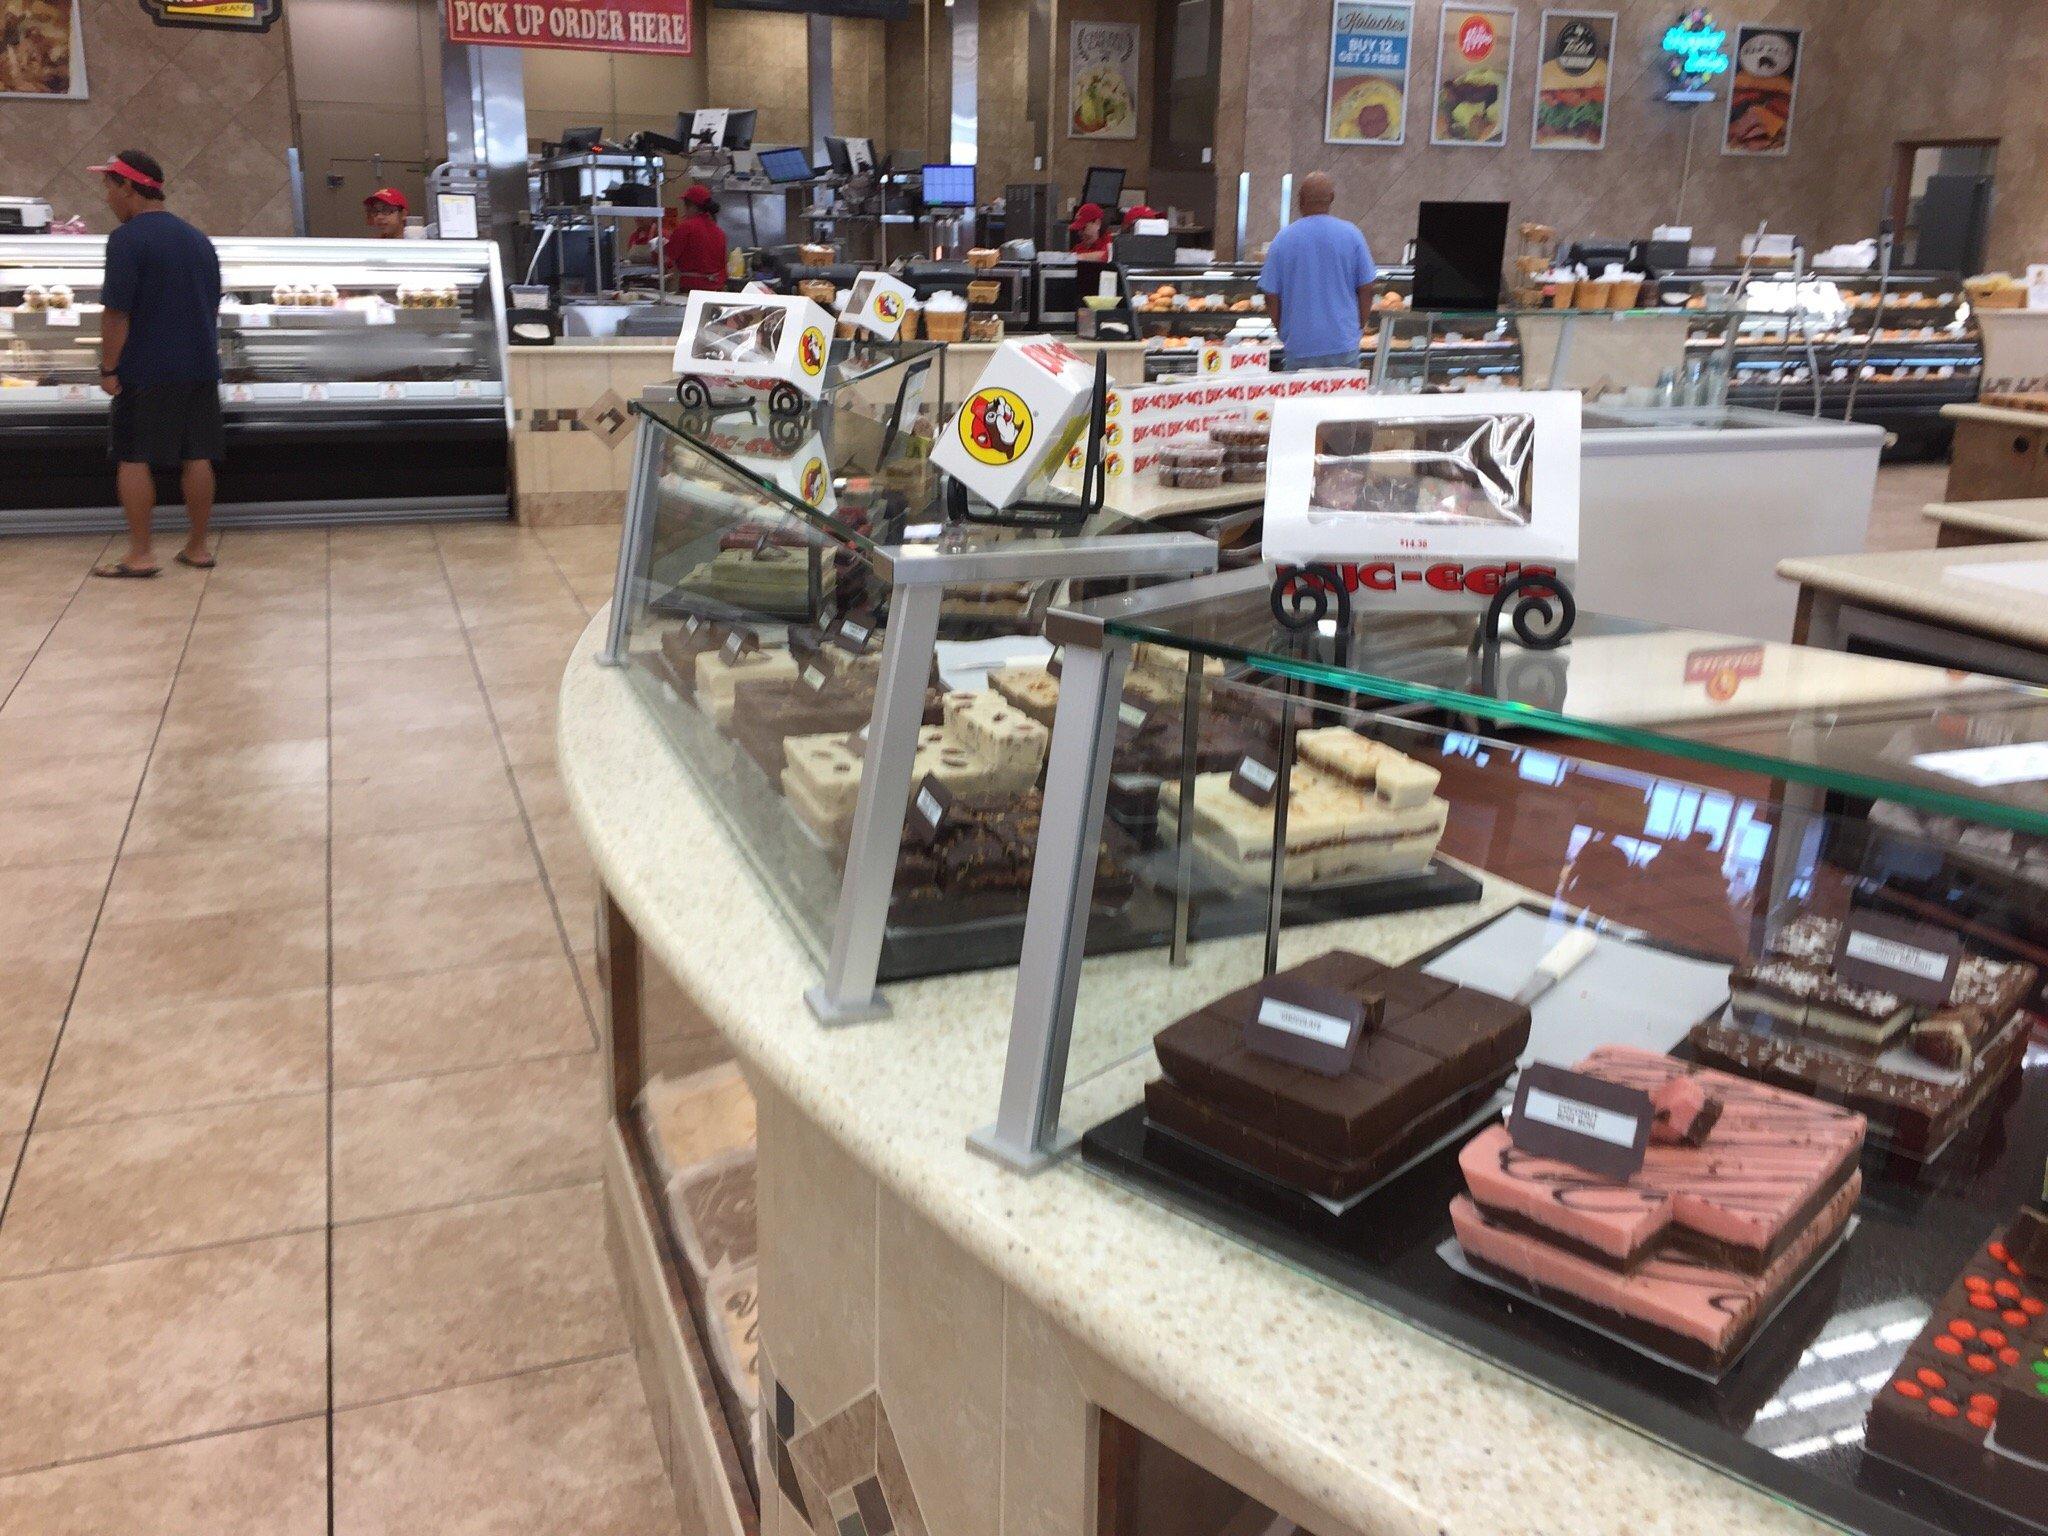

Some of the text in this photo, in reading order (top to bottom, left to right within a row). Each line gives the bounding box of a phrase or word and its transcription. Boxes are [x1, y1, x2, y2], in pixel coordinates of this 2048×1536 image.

[454, 1, 687, 45] PICK UP ORDER HERE
[1337, 10, 1405, 35] Kolaches
[1349, 38, 1377, 53] BUY
[1371, 52, 1401, 65] FREE
